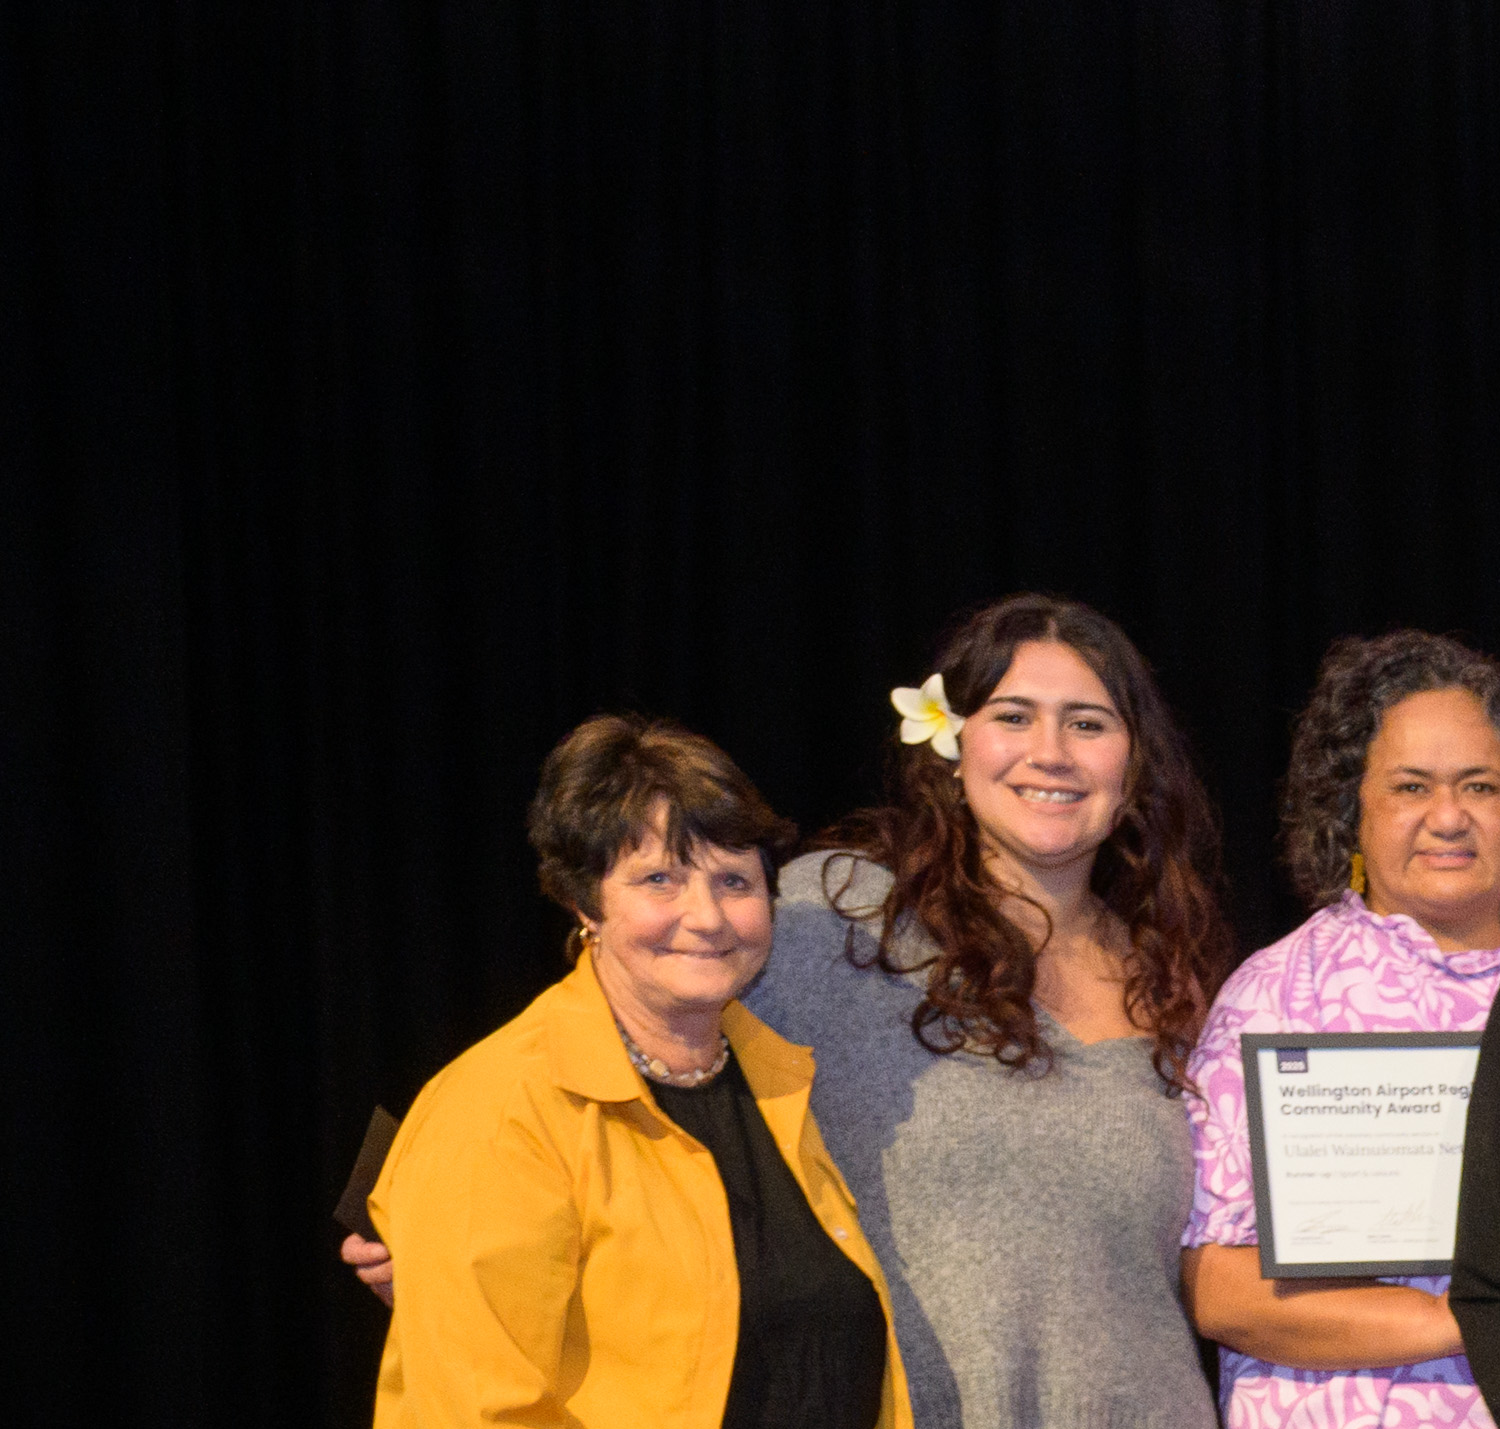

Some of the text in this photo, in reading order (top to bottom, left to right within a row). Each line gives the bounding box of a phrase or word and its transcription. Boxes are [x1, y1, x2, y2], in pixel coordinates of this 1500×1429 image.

[1279, 1083, 1371, 1101] Wellington
[1377, 1083, 1433, 1099] Airport
[1280, 1102, 1441, 1118] Community Award
